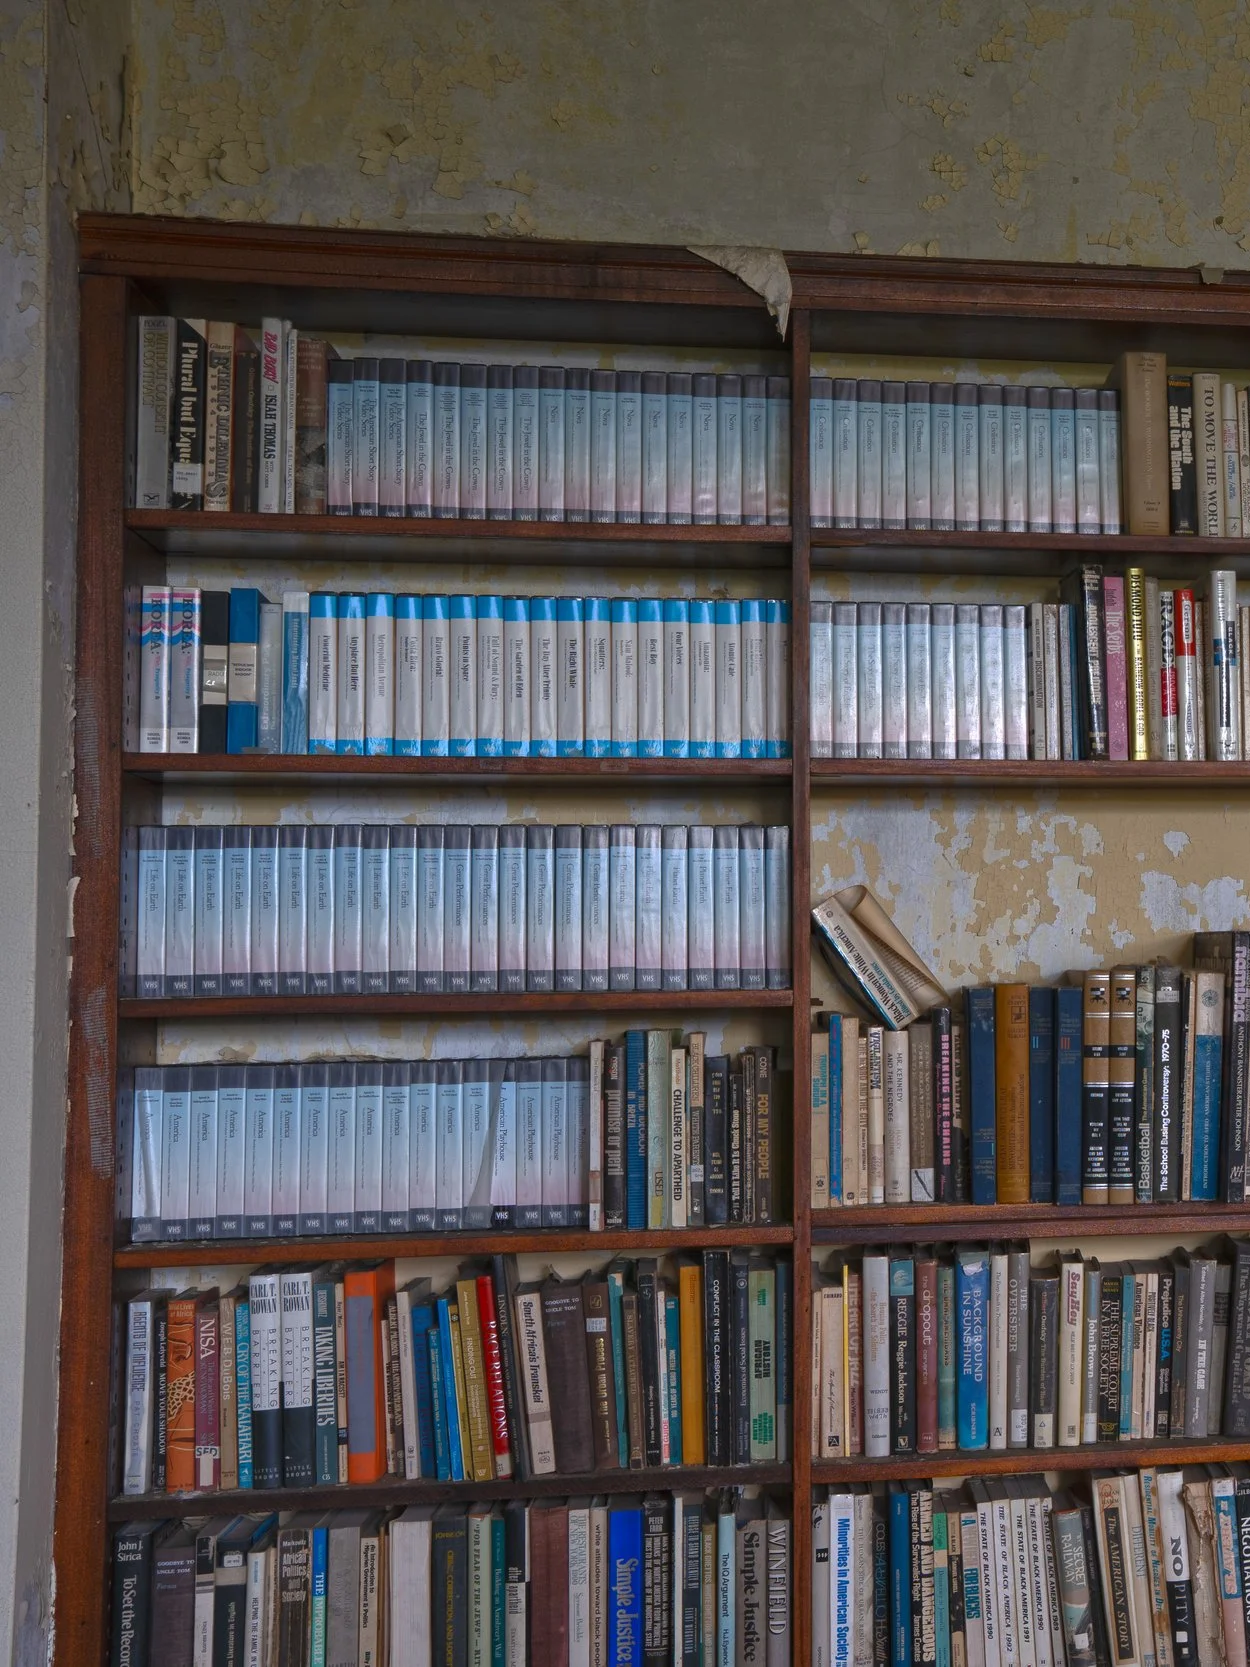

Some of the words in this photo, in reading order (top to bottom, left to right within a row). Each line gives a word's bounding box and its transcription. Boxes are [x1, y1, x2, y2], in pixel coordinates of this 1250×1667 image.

[180, 342, 198, 392] Plural
[180, 396, 197, 422] but
[264, 394, 277, 420] ISIAH
[1204, 387, 1214, 407] TO
[703, 414, 711, 431] Nova
[1169, 406, 1180, 428] and
[1181, 407, 1192, 429] The
[1204, 411, 1216, 452] MOVE
[175, 427, 196, 465] Equa
[264, 423, 276, 459] THOMAS
[1170, 429, 1181, 448] the
[1181, 431, 1193, 464] South
[1170, 451, 1182, 490] Nation
[1206, 456, 1217, 486] THE
[181, 598, 193, 655] KOREA:
[1105, 610, 1122, 629] The
[1160, 600, 1174, 664] RAGE
[1106, 630, 1124, 655] Serbs
[1035, 660, 1044, 709] DISCRIMINATION
[263, 867, 271, 879] Life
[263, 880, 270, 889] on
[262, 891, 271, 910] Earth
[759, 1056, 767, 1078] CONE
[940, 1034, 950, 1094] BREAKING
[673, 1089, 683, 1137] CHALLENGE
[758, 1094, 769, 1116] FOR
[942, 1097, 951, 1119] THE
[257, 1110, 266, 1139] America
[758, 1118, 768, 1135] MY
[942, 1121, 951, 1165] CHAINS
[673, 1139, 682, 1151] TO
[758, 1137, 768, 1179] PEOPLE
[1139, 1123, 1152, 1189] Basketball
[673, 1152, 683, 1201] APARTHEID
[251, 1222, 265, 1230] VHS
[522, 1301, 535, 1328] South
[919, 1289, 932, 1345] dropout
[962, 1291, 971, 1305] IN
[1160, 1278, 1171, 1328] Prejudice
[200, 1318, 215, 1359] NISA
[315, 1325, 334, 1366] TAKING
[525, 1329, 540, 1363] Africa's
[962, 1309, 972, 1376] SUNSHINE
[973, 1290, 982, 1382] BACKGROUND
[1161, 1329, 1171, 1361] U.S.A.
[284, 1328, 294, 1407] BARRIERS
[301, 1326, 311, 1406] BREAKING
[530, 1364, 544, 1403] Transkei
[316, 1369, 335, 1426] LIBERTIES
[919, 1492, 932, 1541] ARMED
[1108, 1515, 1117, 1534] The
[722, 1553, 730, 1566] The
[837, 1518, 850, 1567] Minorities
[921, 1545, 933, 1574] AND
[1171, 1536, 1184, 1577] NO
[612, 1558, 638, 1606] Simple
[721, 1567, 730, 1577] IQ
[740, 1532, 760, 1596] Simple
[767, 1527, 786, 1635] WINFIELD
[837, 1568, 849, 1577] in
[1110, 1538, 1124, 1607] AMERICAN
[721, 1579, 730, 1617] Argument
[837, 1579, 851, 1625] American
[1175, 1584, 1188, 1625] PITY
[616, 1609, 638, 1661] Justice
[744, 1598, 761, 1662] Justice
[921, 1577, 935, 1662] DANGEROUS
[1117, 1612, 1129, 1650] STORY
[836, 1627, 851, 1661] Society
